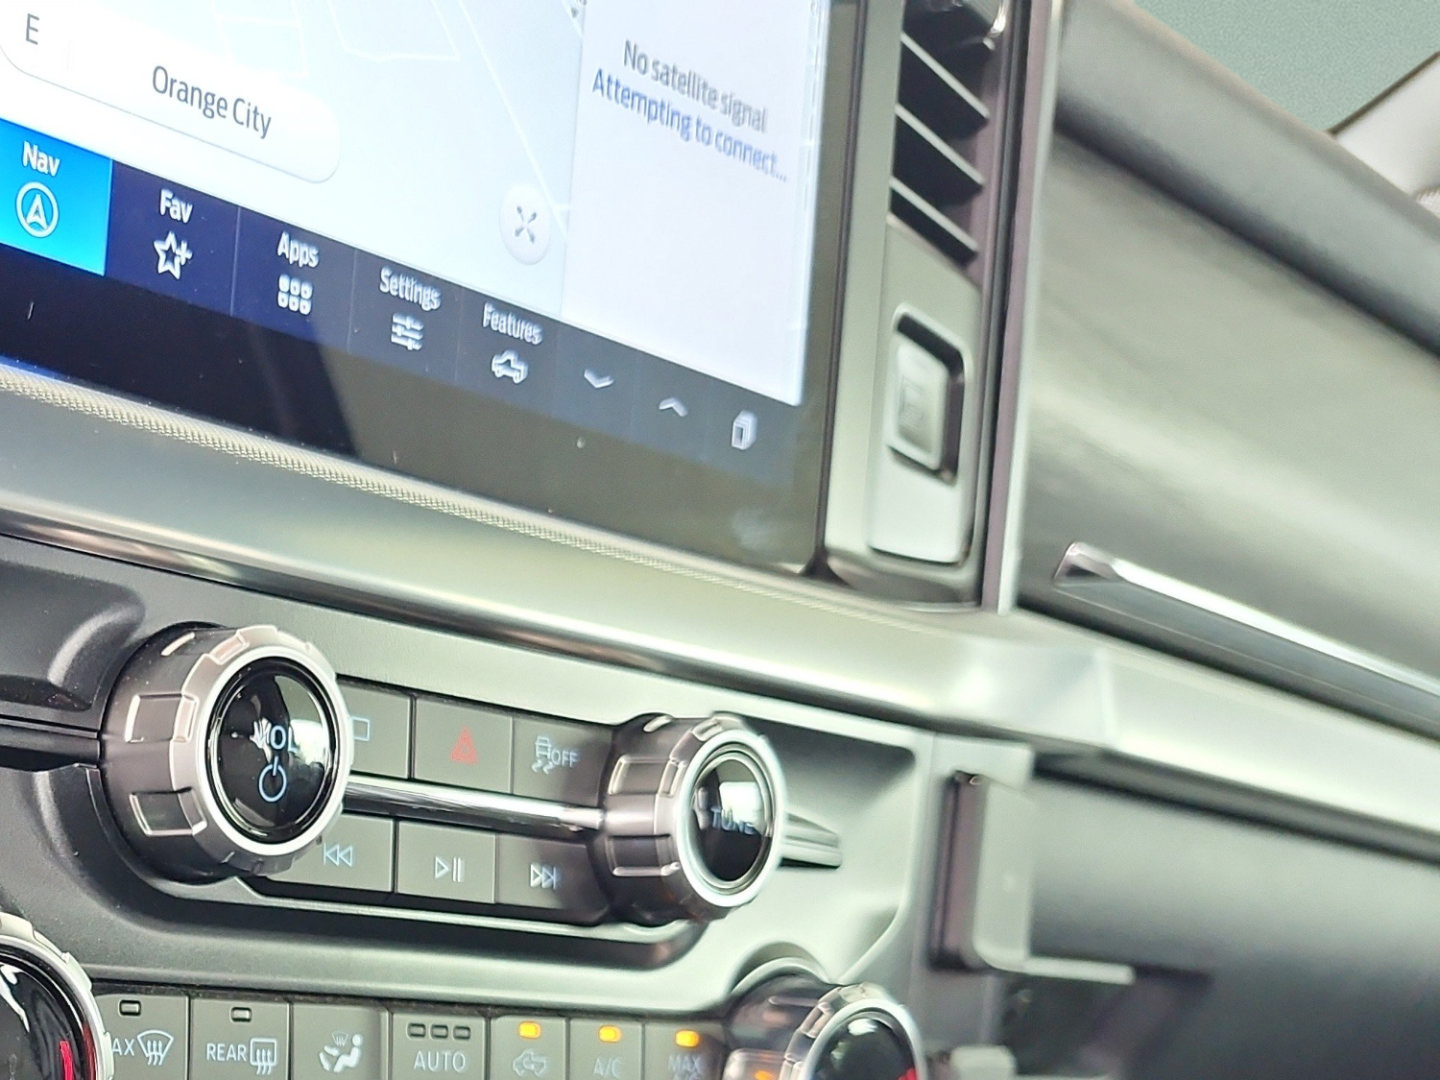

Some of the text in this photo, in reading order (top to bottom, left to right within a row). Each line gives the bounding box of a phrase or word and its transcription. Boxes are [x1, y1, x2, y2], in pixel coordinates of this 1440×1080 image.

[24, 14, 40, 45] E
[151, 65, 273, 140] Orange City
[623, 40, 768, 134] No satellite signal
[592, 68, 787, 183] Attempting to connect...
[22, 141, 60, 177] Nav
[159, 189, 192, 224] Fav
[277, 232, 319, 268] Apps
[379, 267, 441, 311] Settings
[482, 304, 542, 345] Features
[551, 748, 580, 767] OFF
[710, 807, 756, 835] TUNE
[112, 1038, 136, 1057] AX
[206, 1043, 247, 1062] REAR
[413, 1049, 466, 1073] AUTO
[668, 1053, 703, 1074] MAX
[593, 1055, 623, 1079] A/C
